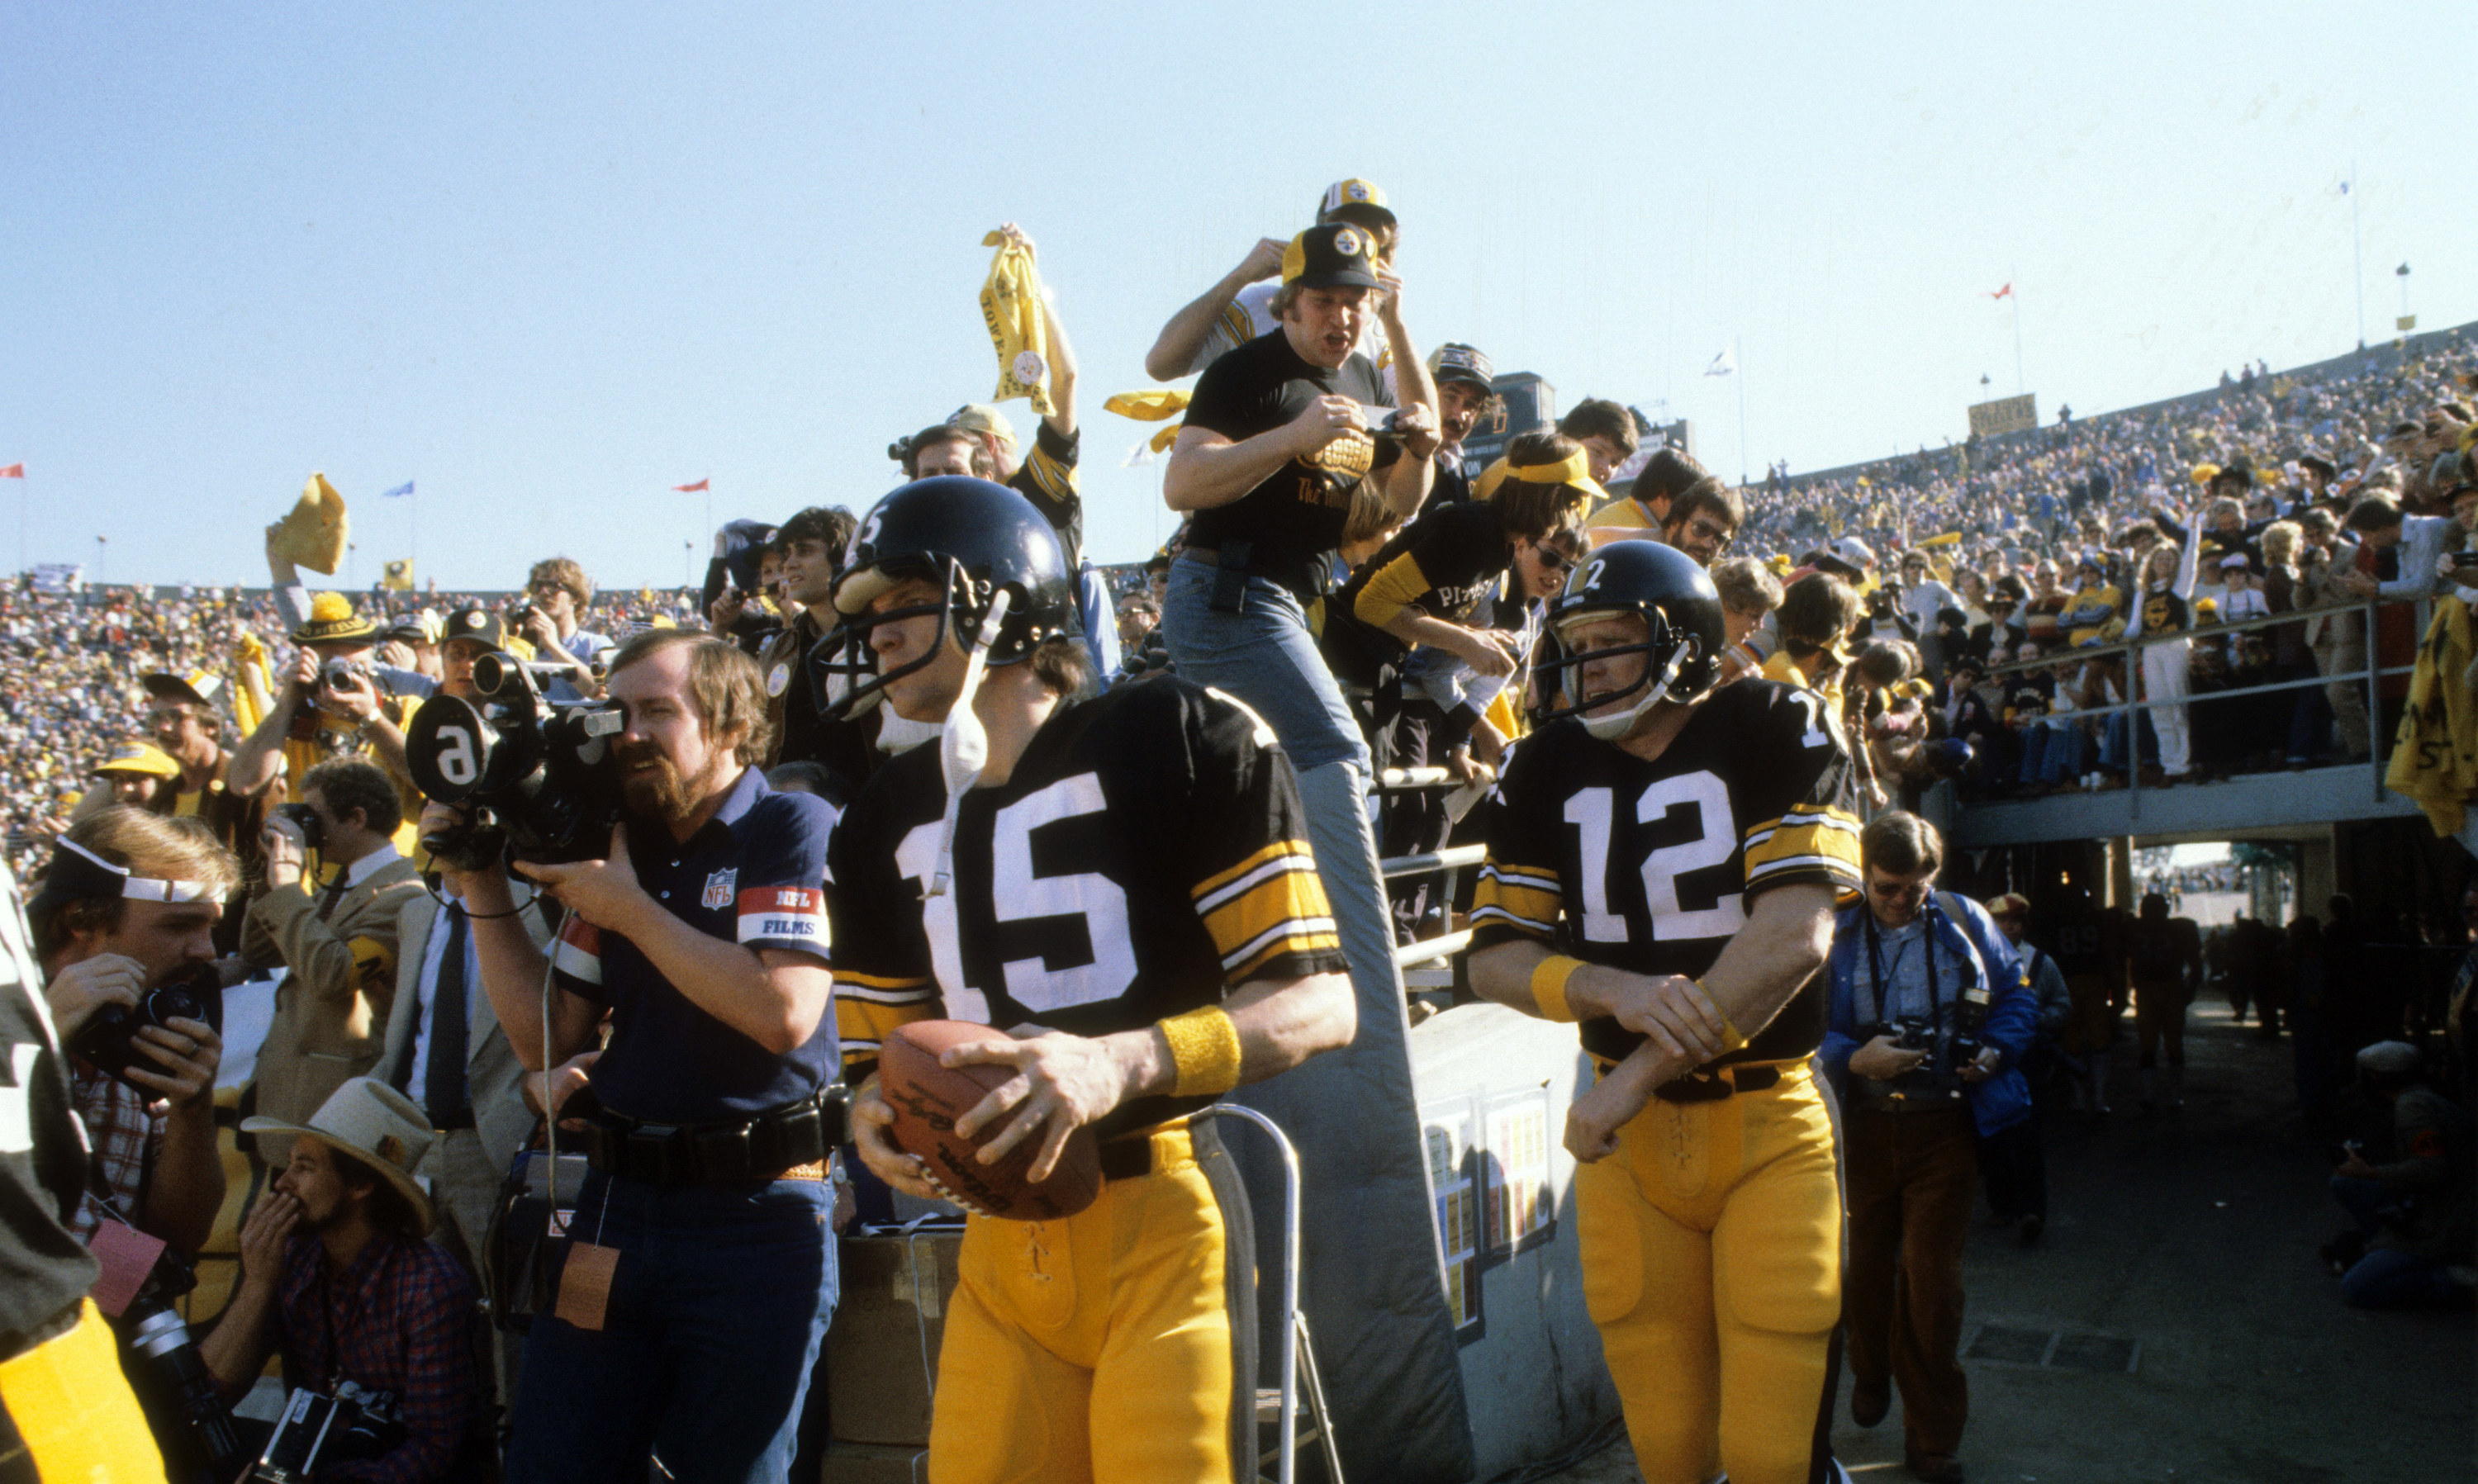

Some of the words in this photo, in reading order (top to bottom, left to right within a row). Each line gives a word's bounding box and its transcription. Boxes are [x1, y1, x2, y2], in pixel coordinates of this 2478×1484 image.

[1563, 770, 1745, 942] 12
[705, 885, 731, 906] NFL
[776, 890, 810, 908] NFL
[895, 770, 1138, 1024] 15
[762, 919, 815, 935] FILMS
